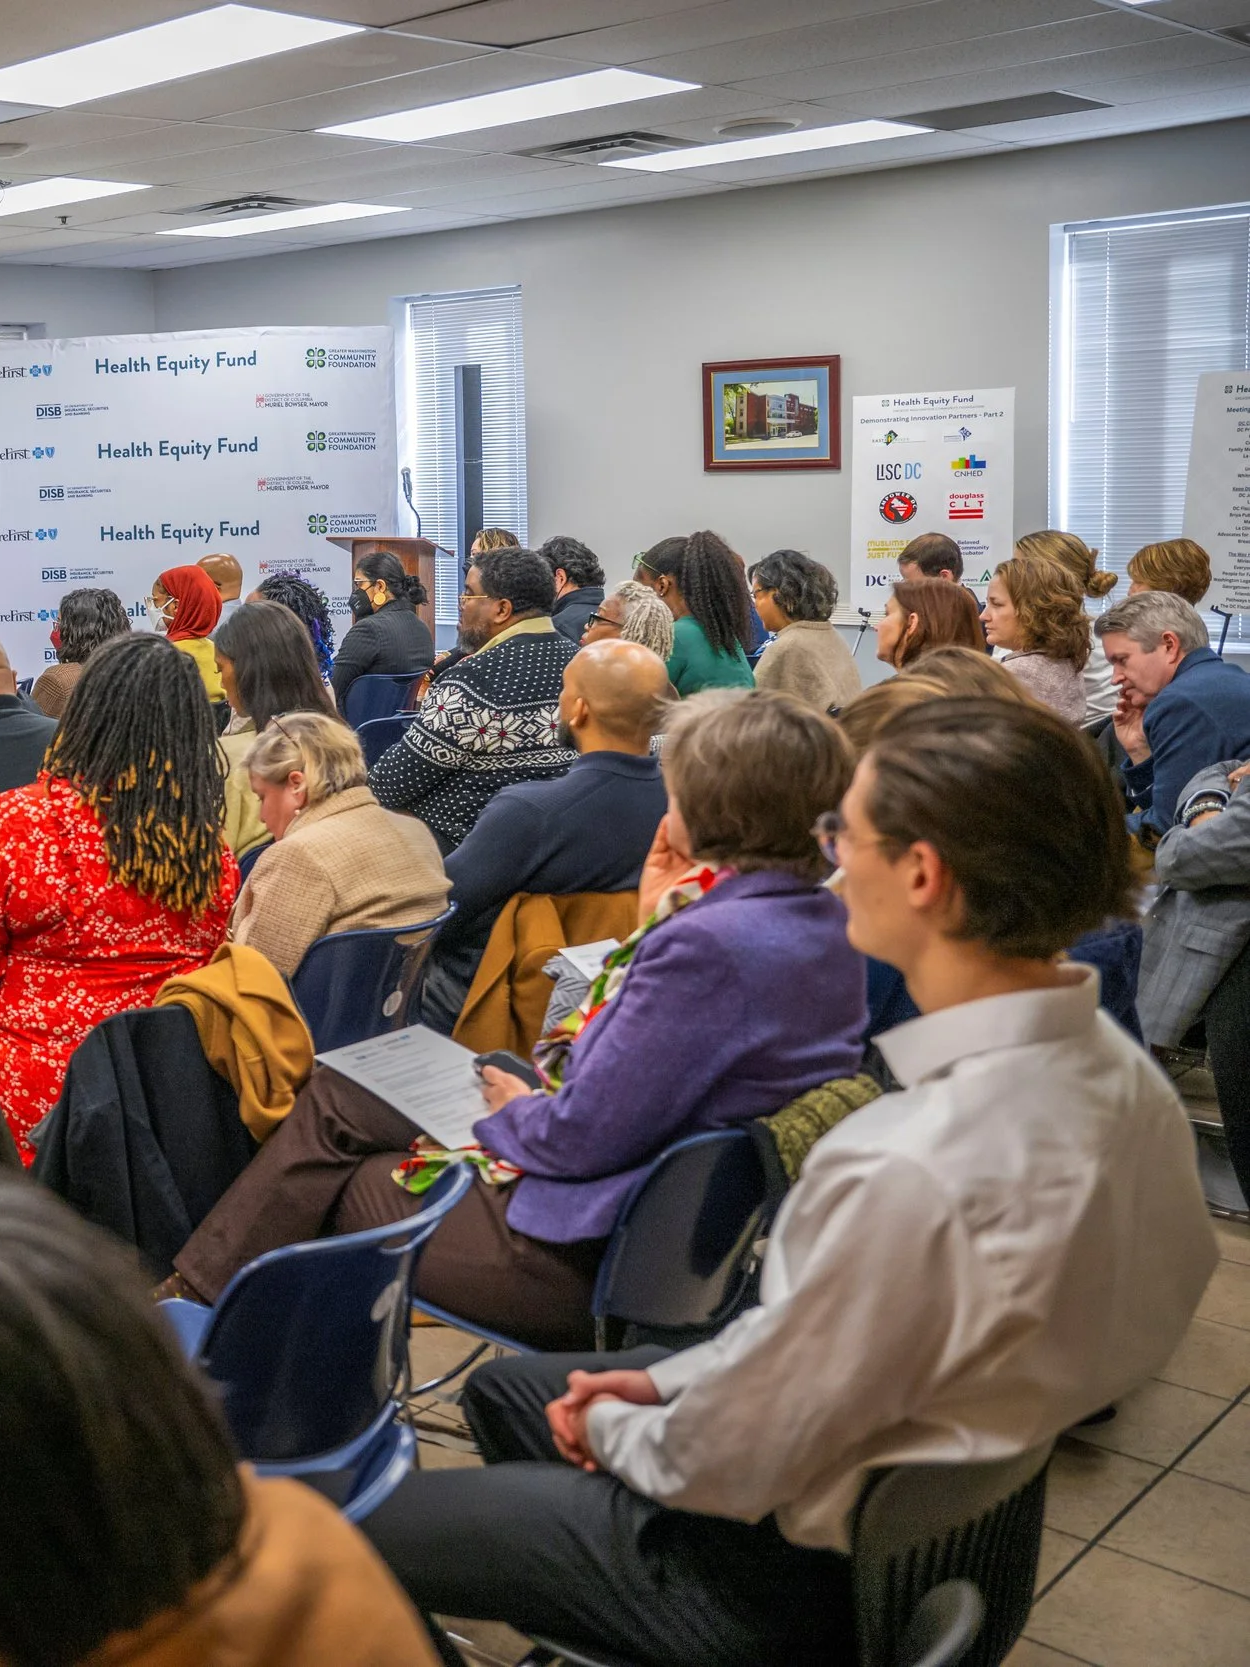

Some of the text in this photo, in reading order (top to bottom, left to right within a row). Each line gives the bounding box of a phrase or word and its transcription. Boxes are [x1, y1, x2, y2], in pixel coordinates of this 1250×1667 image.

[95, 350, 257, 376] Health Equity Fund
[1236, 385, 1250, 393] Hea
[893, 395, 974, 406] Health Equity Fund
[36, 406, 62, 417] DISB
[860, 416, 910, 424] Demonstrating
[98, 436, 258, 461] Health Equity Fund
[876, 462, 922, 480] LISC DC
[39, 488, 65, 499] DISB
[100, 520, 260, 544] Health Equity Fund
[41, 570, 67, 580] DISB
